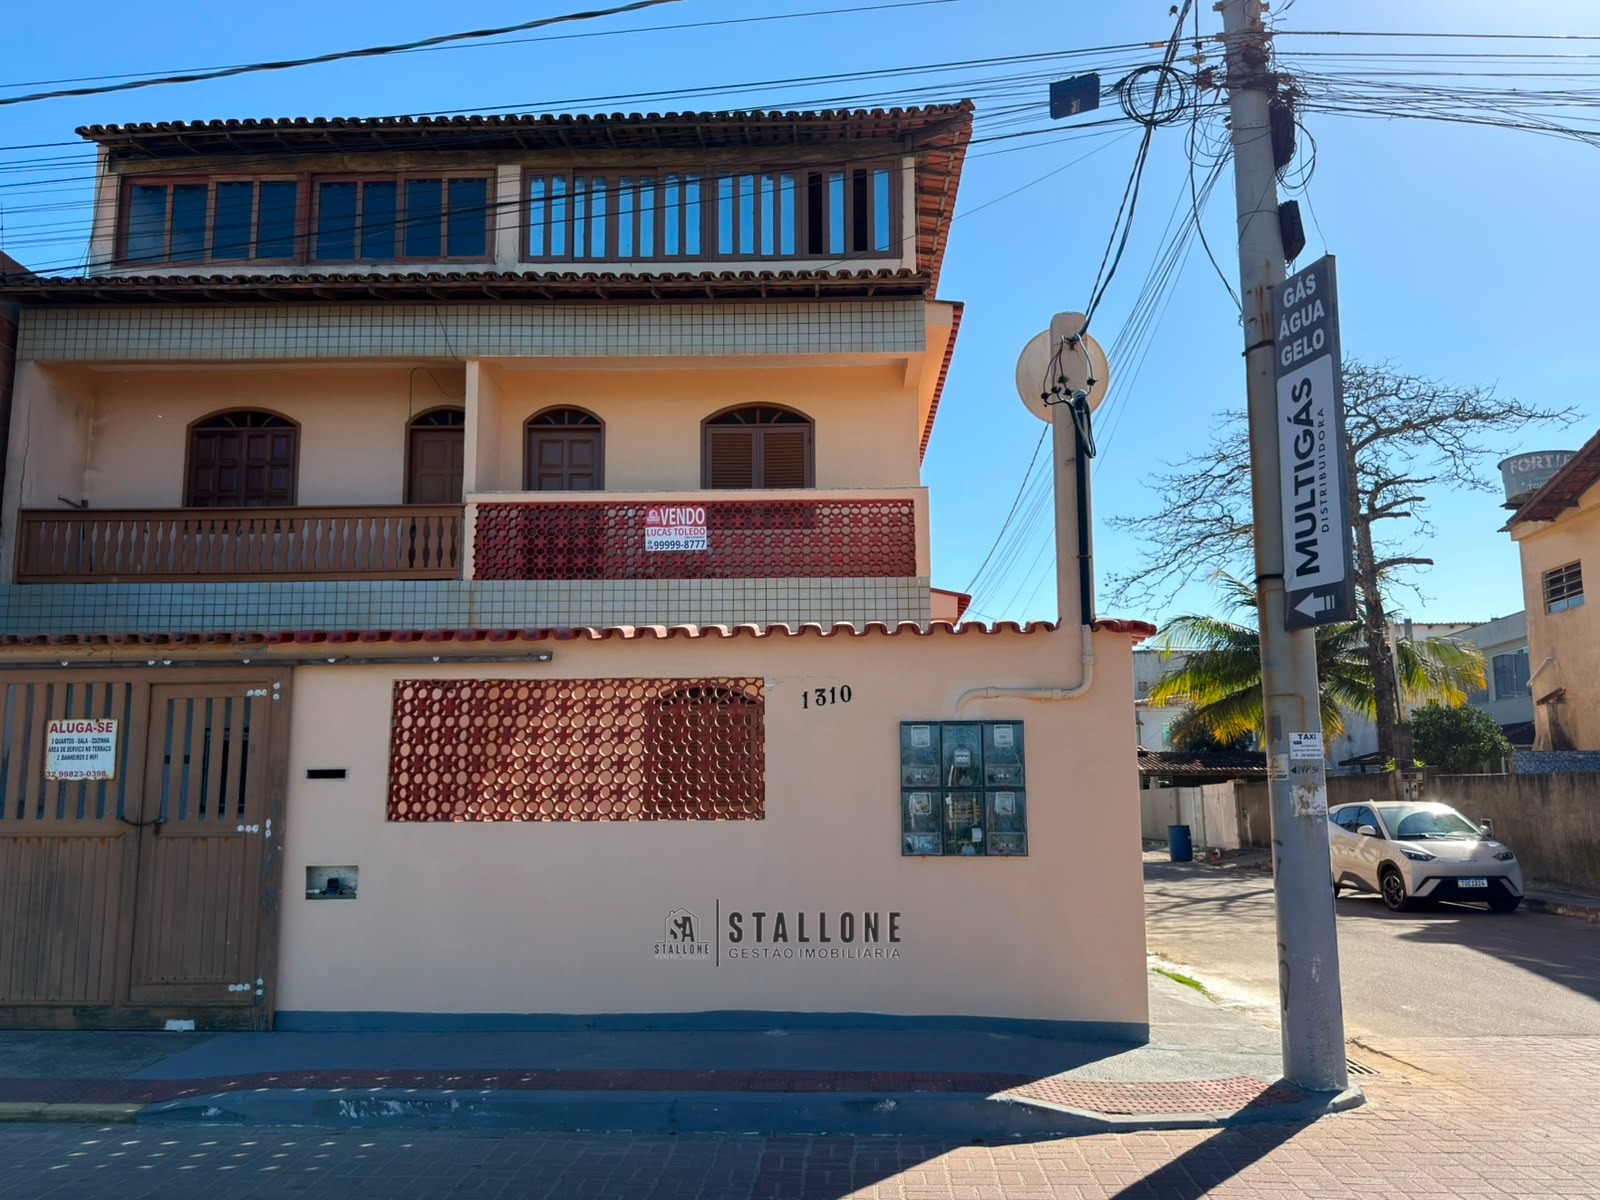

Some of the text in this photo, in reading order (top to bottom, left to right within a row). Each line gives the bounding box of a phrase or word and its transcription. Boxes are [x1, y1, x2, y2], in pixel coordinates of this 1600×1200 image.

[1283, 273, 1316, 308] GÁS
[1279, 299, 1325, 341] ÁGUA
[1281, 328, 1325, 366] GELO
[1287, 376, 1320, 577] MULTIGÁS
[1317, 408, 1329, 532] DISTRIBUIDORA
[660, 507, 705, 525] VENDO
[646, 527, 706, 537] LUCAS TOLEDO
[653, 539, 706, 550] 99999-8777
[802, 685, 852, 709] 1310
[49, 722, 114, 734] ALUGA-SE
